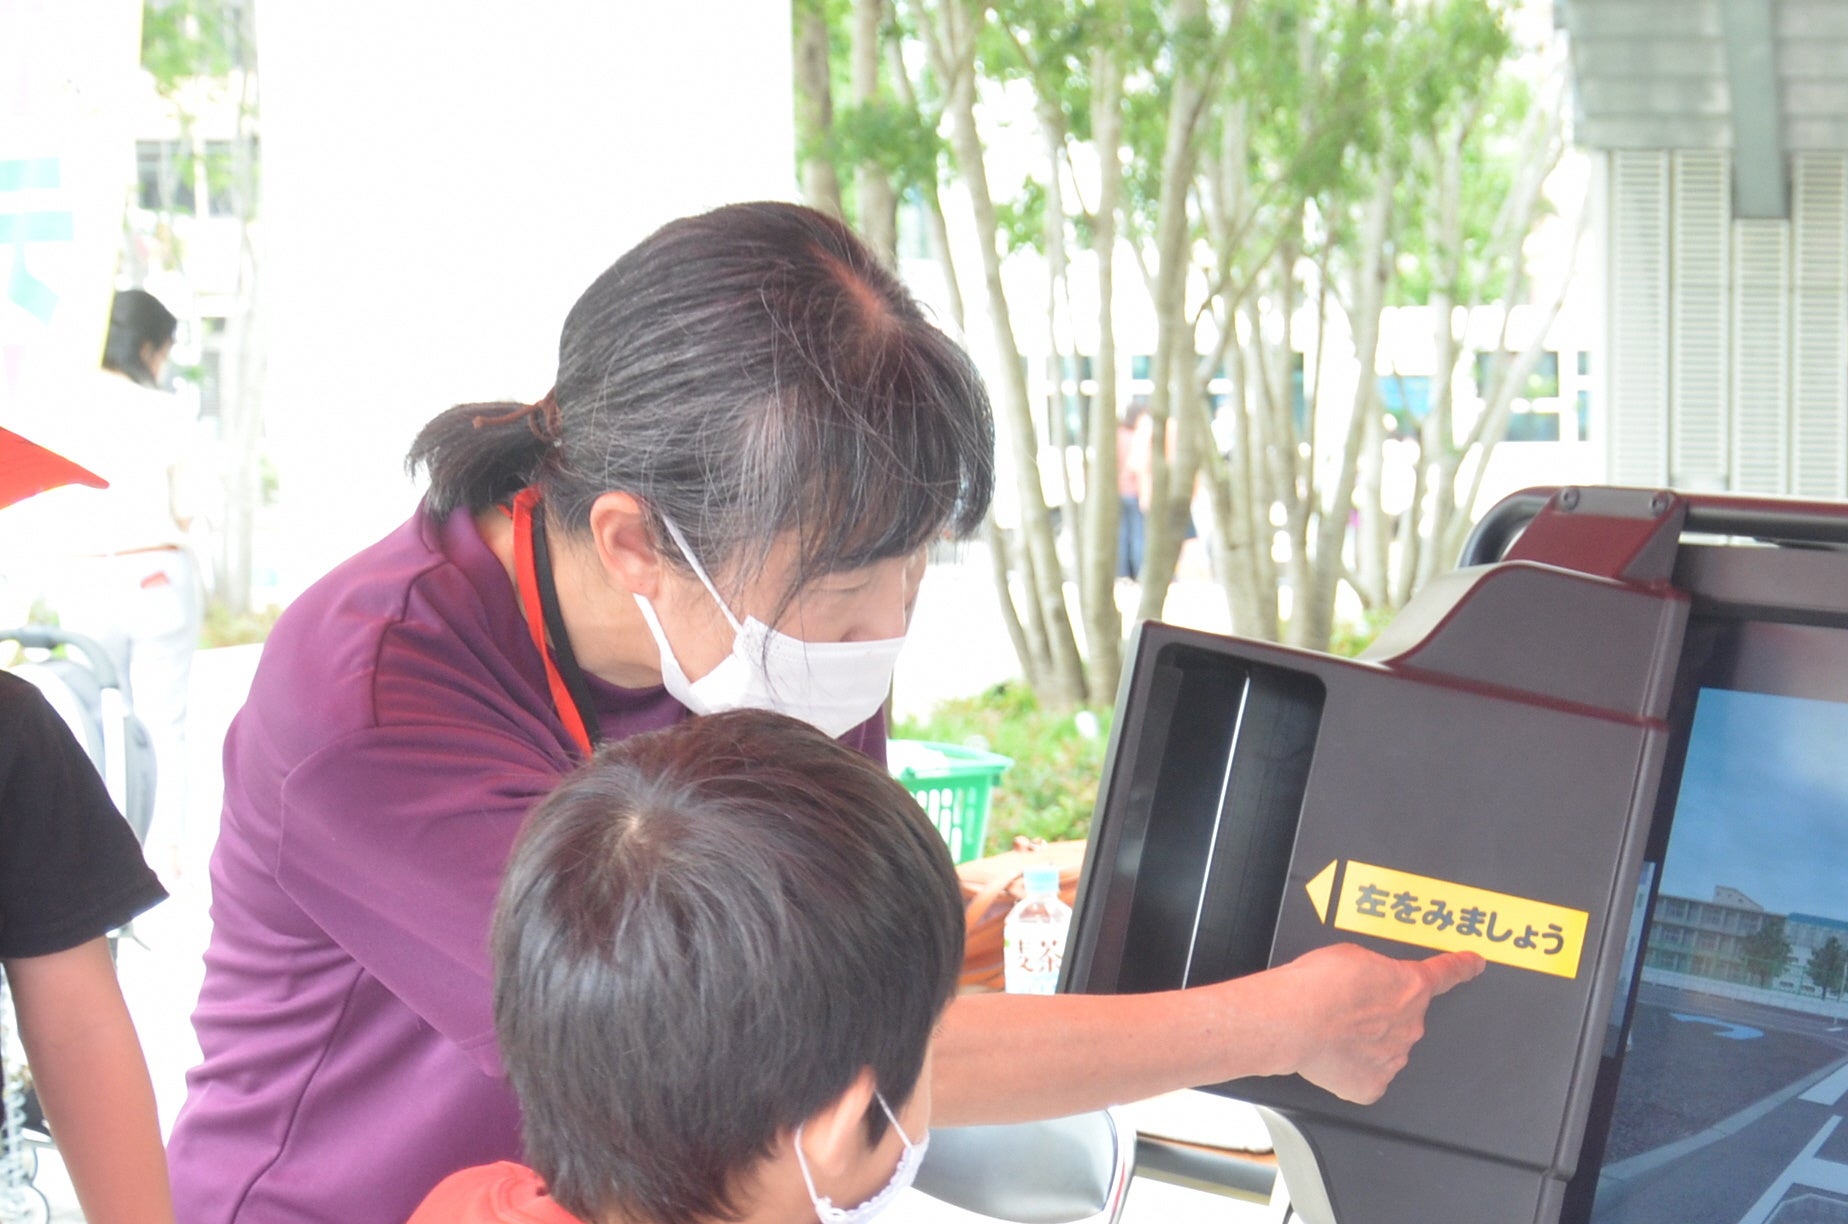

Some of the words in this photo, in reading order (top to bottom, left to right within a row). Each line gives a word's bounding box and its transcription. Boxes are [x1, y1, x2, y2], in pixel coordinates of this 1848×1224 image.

[1354, 883, 1564, 955] 左をみましょう
